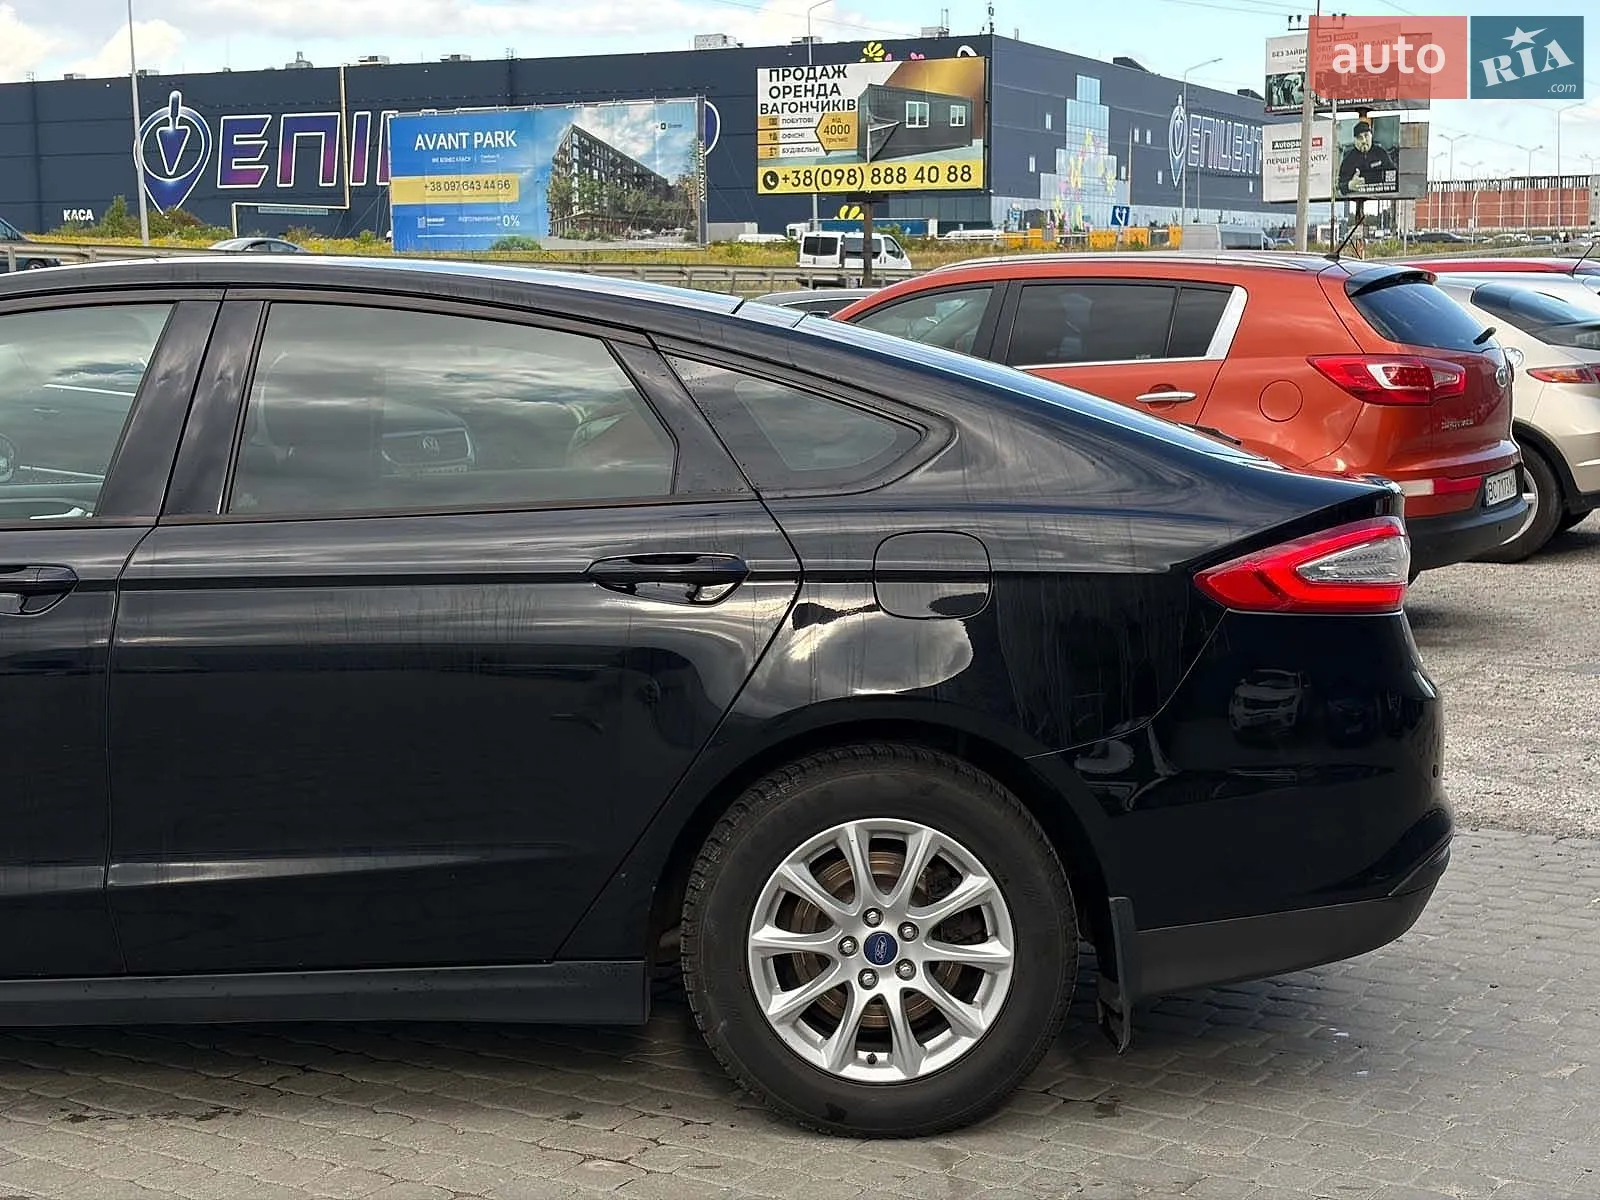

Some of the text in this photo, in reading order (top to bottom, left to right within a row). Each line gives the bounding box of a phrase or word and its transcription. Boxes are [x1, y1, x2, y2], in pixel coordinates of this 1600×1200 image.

[769, 65, 848, 82] ПРОДАЖ
[768, 83, 841, 99] ОРЕНДА
[760, 99, 856, 115] ВАГОНЧИКІВ
[823, 124, 850, 136] 4000
[415, 130, 517, 151] AVANT PARK
[782, 165, 971, 191] +38(098) 888 40 88
[63, 208, 94, 221] КАСА
[502, 214, 520, 227] 0%
